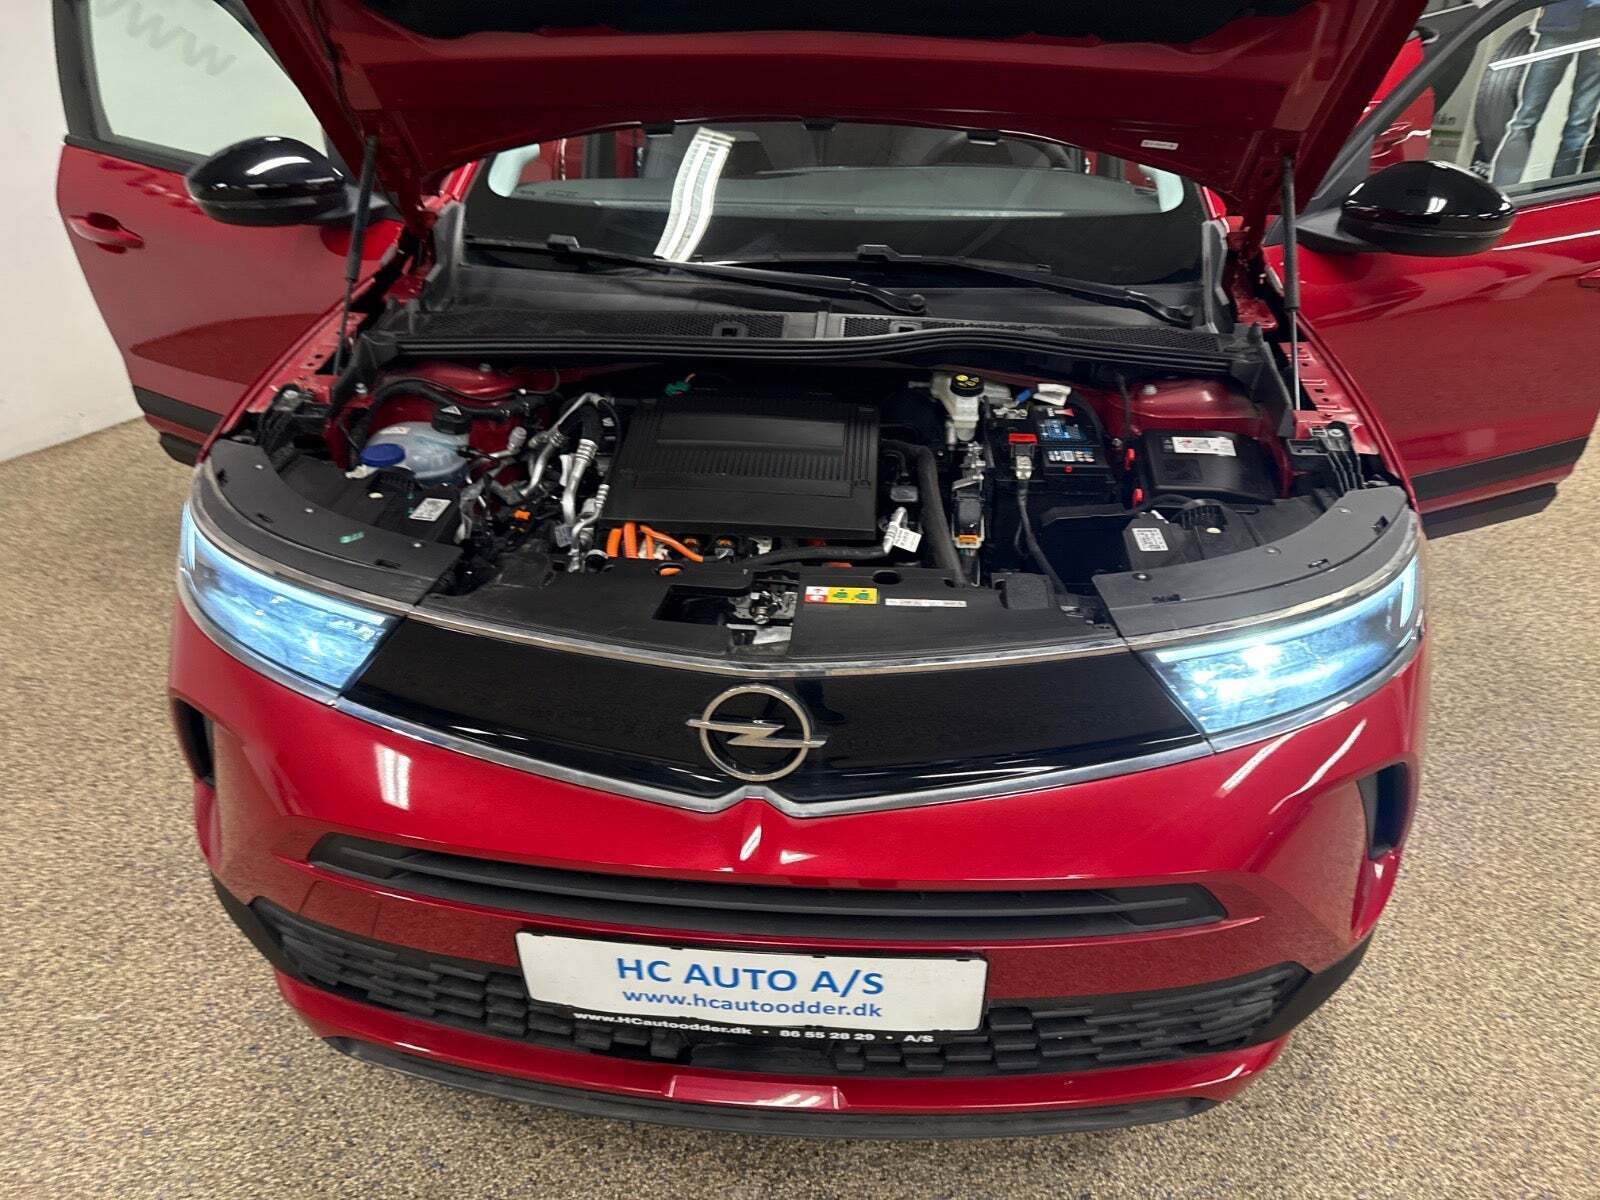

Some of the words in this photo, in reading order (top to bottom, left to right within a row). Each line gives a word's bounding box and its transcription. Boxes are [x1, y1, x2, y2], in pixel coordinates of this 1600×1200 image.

[615, 957, 672, 983] HC
[684, 963, 797, 992] AUTO
[811, 968, 884, 998] A/S
[622, 990, 882, 1017] www.hcautoodder.dk
[573, 1012, 752, 1035] www.HCautoodder.dk
[779, 1029, 801, 1039] 86
[804, 1030, 826, 1040] 55
[829, 1031, 851, 1041] 28
[853, 1032, 876, 1042] 29
[903, 1033, 934, 1043] A/S
